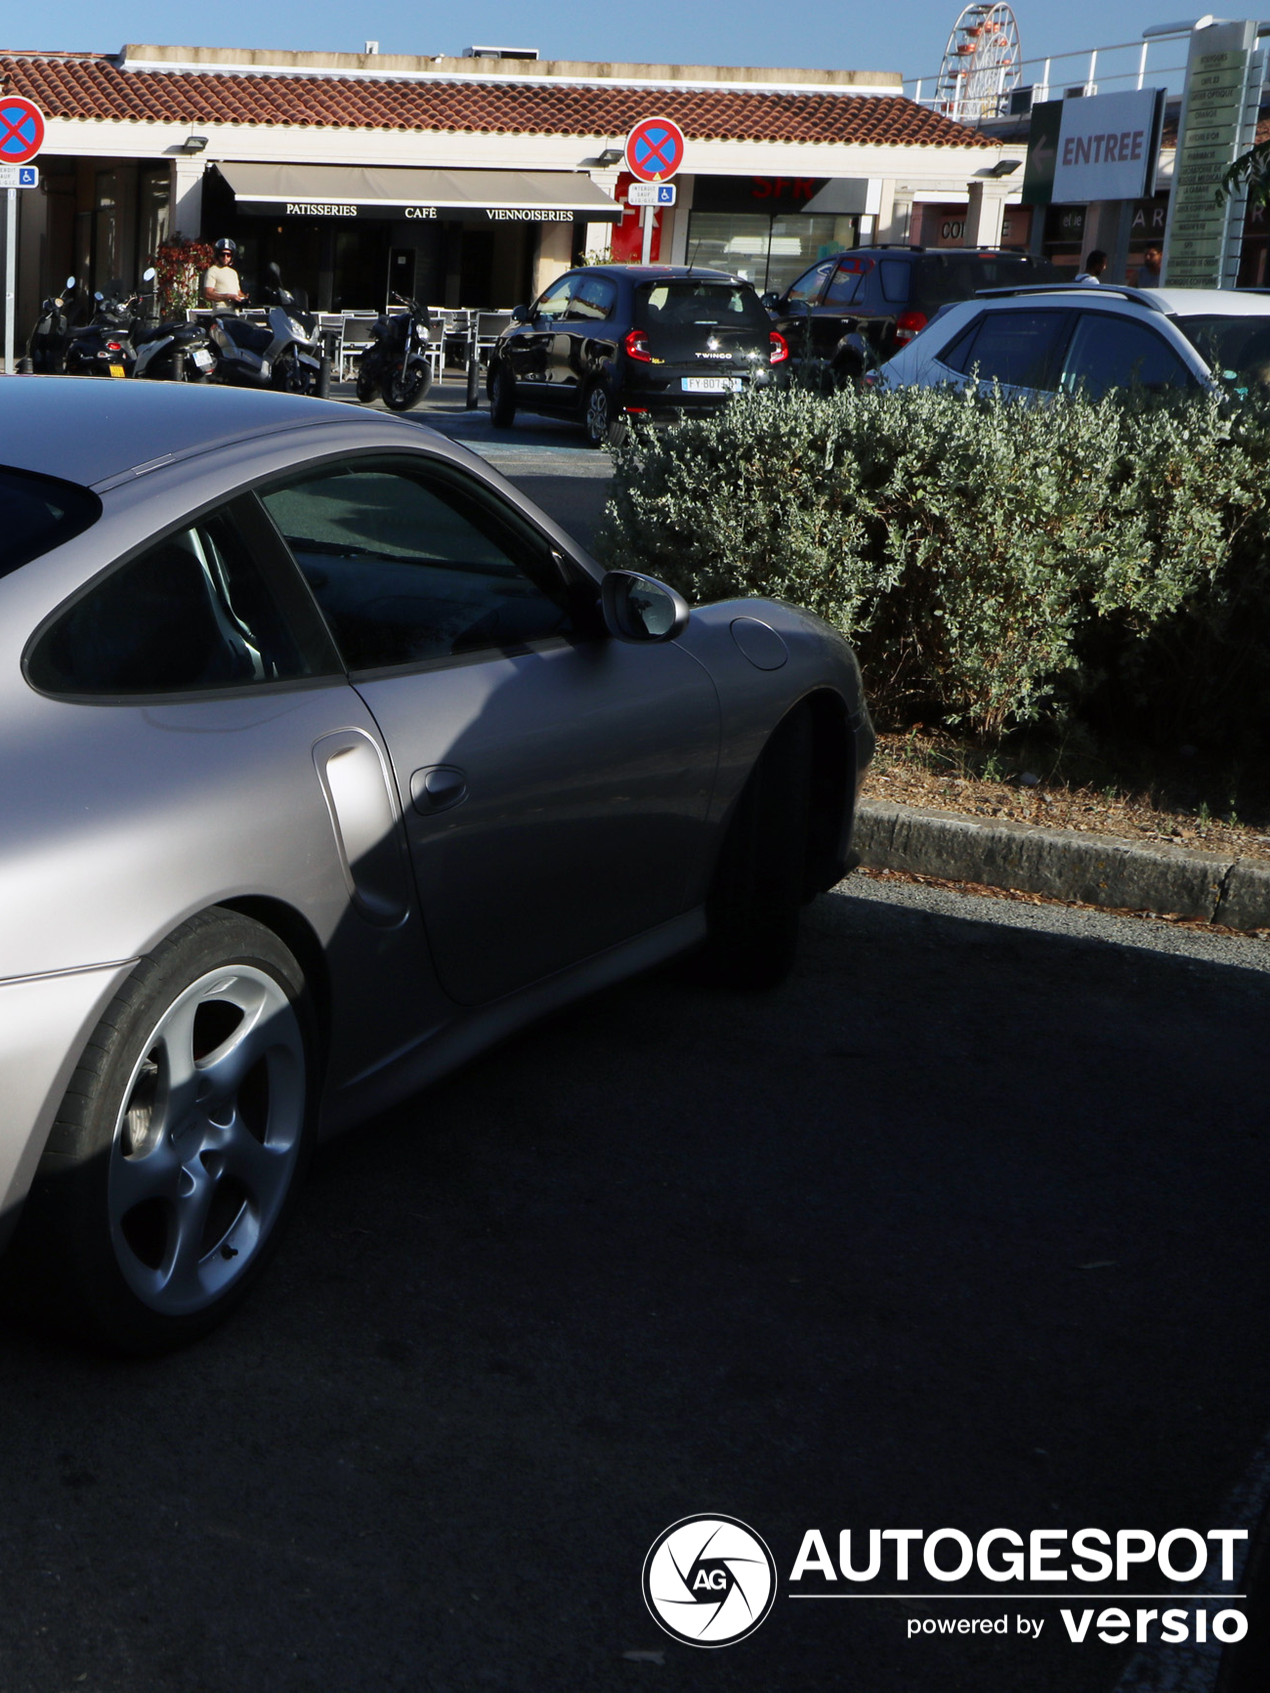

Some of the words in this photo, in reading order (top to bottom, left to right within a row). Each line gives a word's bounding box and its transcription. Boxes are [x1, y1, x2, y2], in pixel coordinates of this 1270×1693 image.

[1062, 130, 1144, 166] ENTREE
[286, 203, 357, 217] PATISSERIES
[486, 208, 574, 222] VIENNOISERIES
